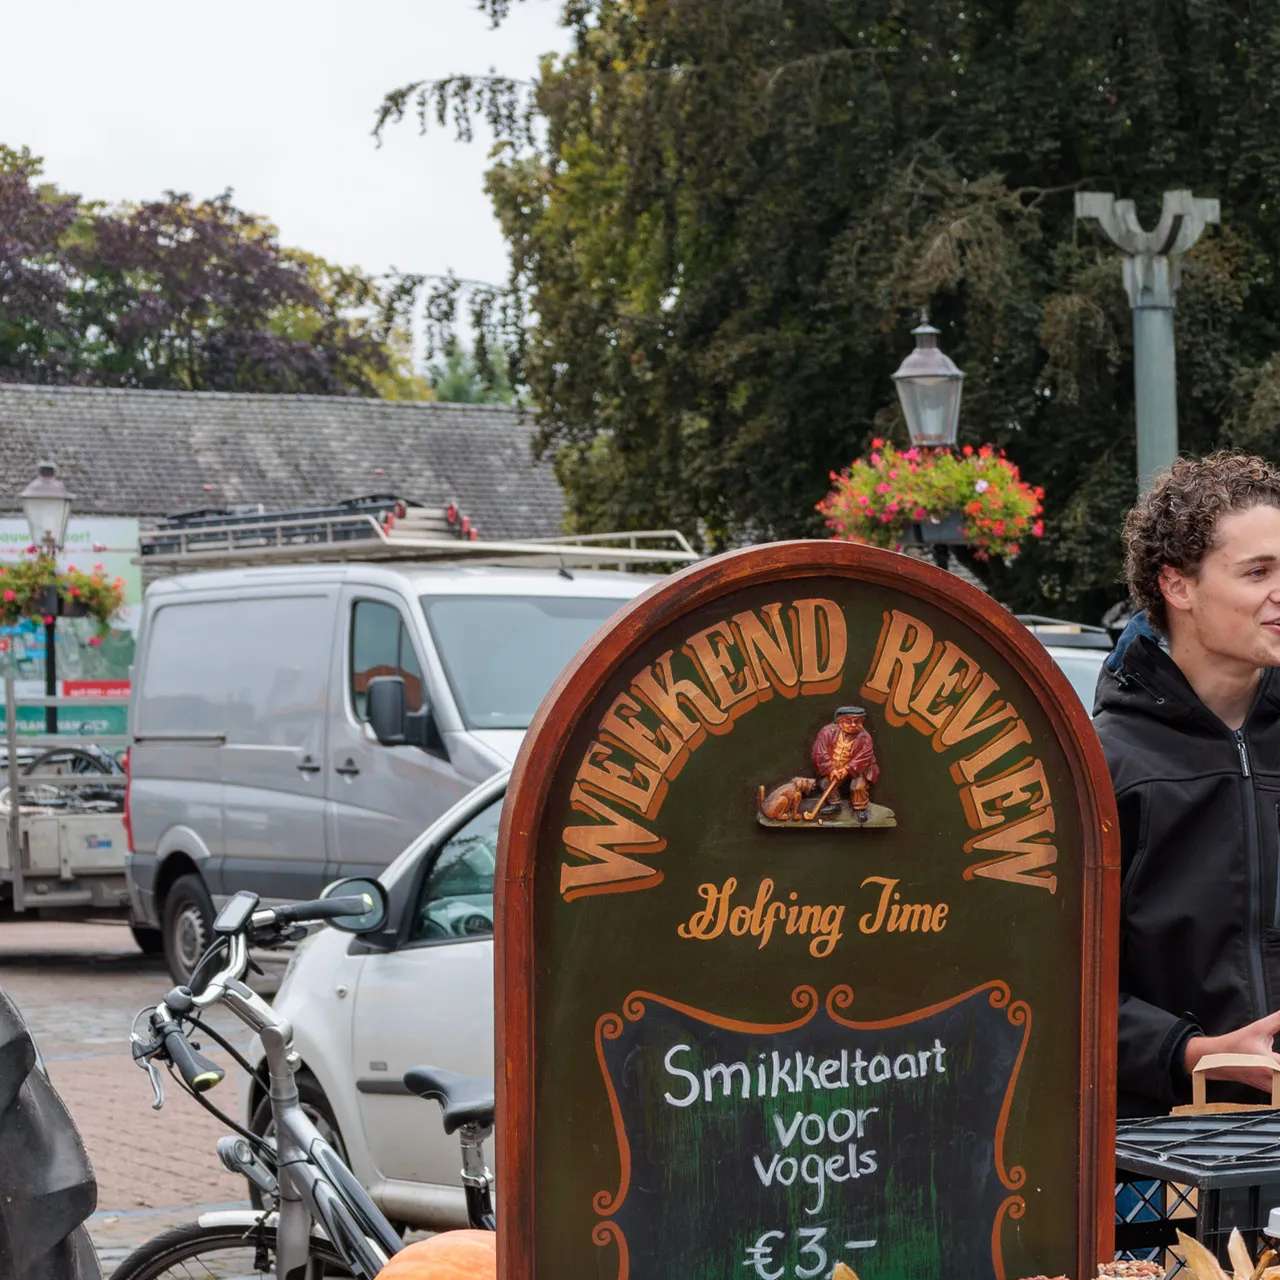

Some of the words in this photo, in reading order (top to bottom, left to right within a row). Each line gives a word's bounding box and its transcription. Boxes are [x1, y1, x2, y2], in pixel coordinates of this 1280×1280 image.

[560, 598, 848, 902] WEEKEND
[861, 610, 1059, 895] REVIEW
[678, 877, 845, 959] Golfing
[859, 876, 949, 936] Time
[663, 1038, 947, 1109] Smikkeltaart
[773, 1105, 879, 1148] voor
[753, 1144, 879, 1216] vogels
